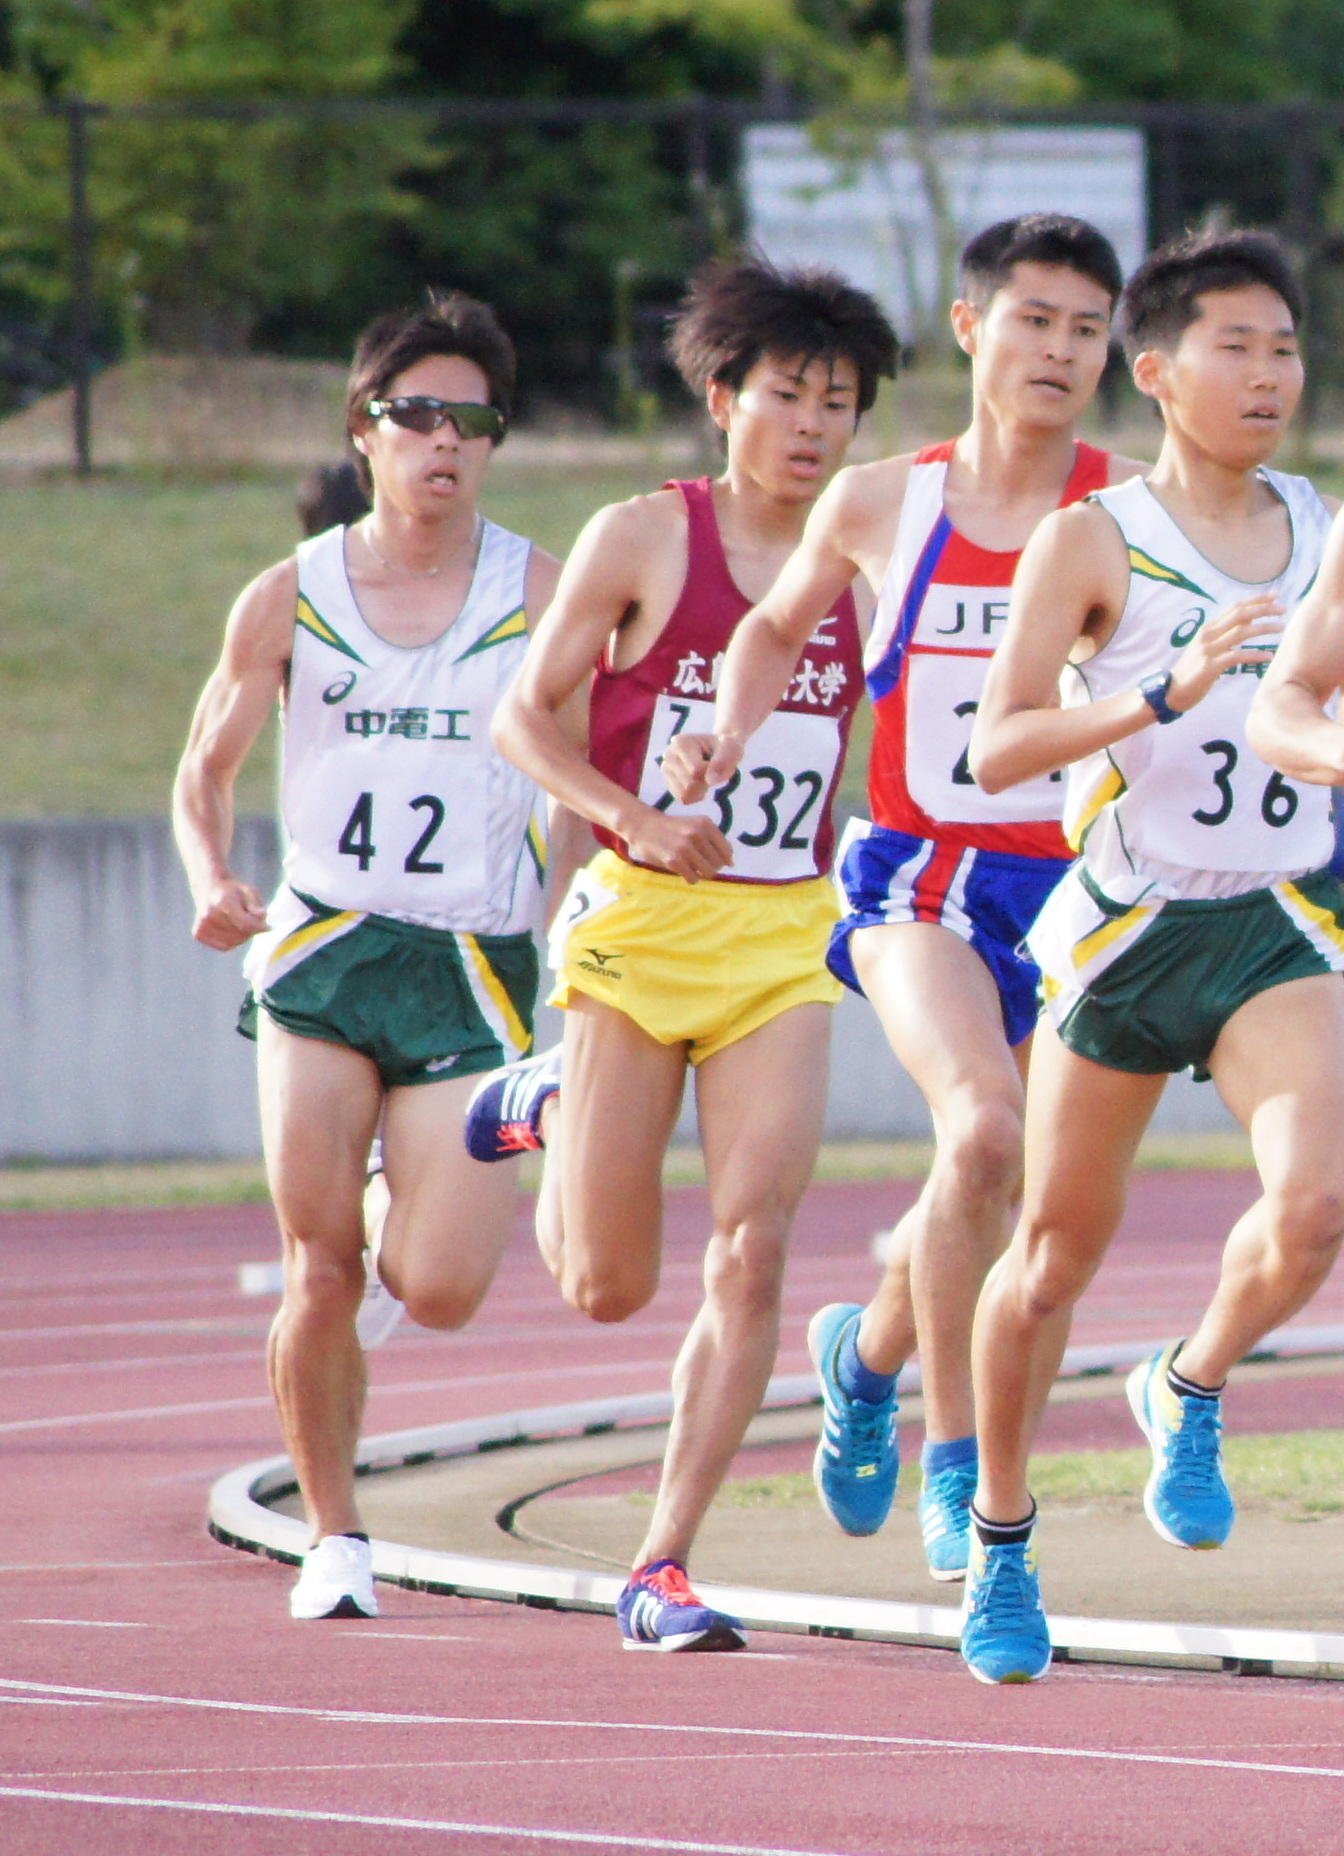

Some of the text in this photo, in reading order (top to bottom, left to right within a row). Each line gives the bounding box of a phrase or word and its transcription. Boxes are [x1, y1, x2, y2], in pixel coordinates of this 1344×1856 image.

[936, 602, 1010, 635] JF
[344, 708, 471, 740] 中電工
[1191, 739, 1299, 828] 36
[338, 791, 446, 874] 42
